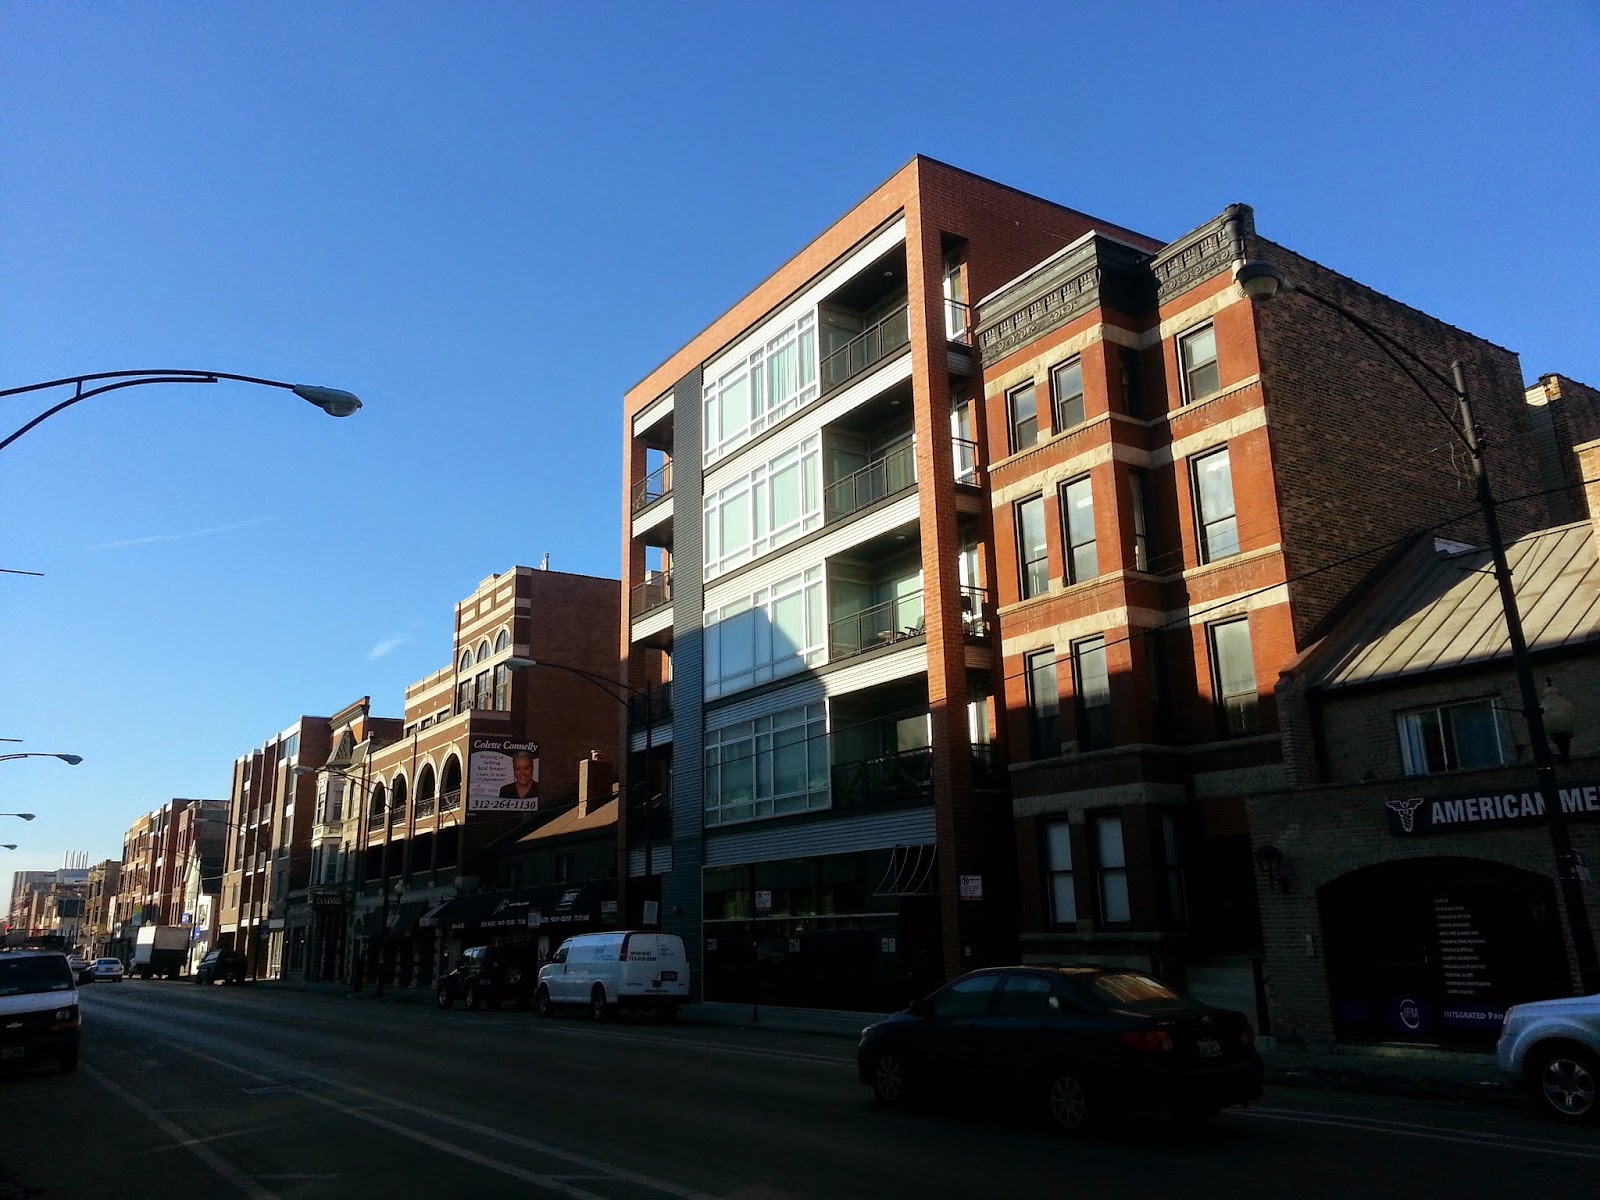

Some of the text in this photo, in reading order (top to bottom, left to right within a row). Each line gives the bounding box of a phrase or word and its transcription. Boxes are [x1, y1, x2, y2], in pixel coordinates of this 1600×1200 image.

[473, 739, 538, 752] Colette Connelly
[472, 799, 537, 810] 312-264-1130
[1431, 785, 1600, 825] AMERICAN ME
[1403, 1007, 1419, 1019] IPM
[1443, 1010, 1486, 1020] INTEGRATED
